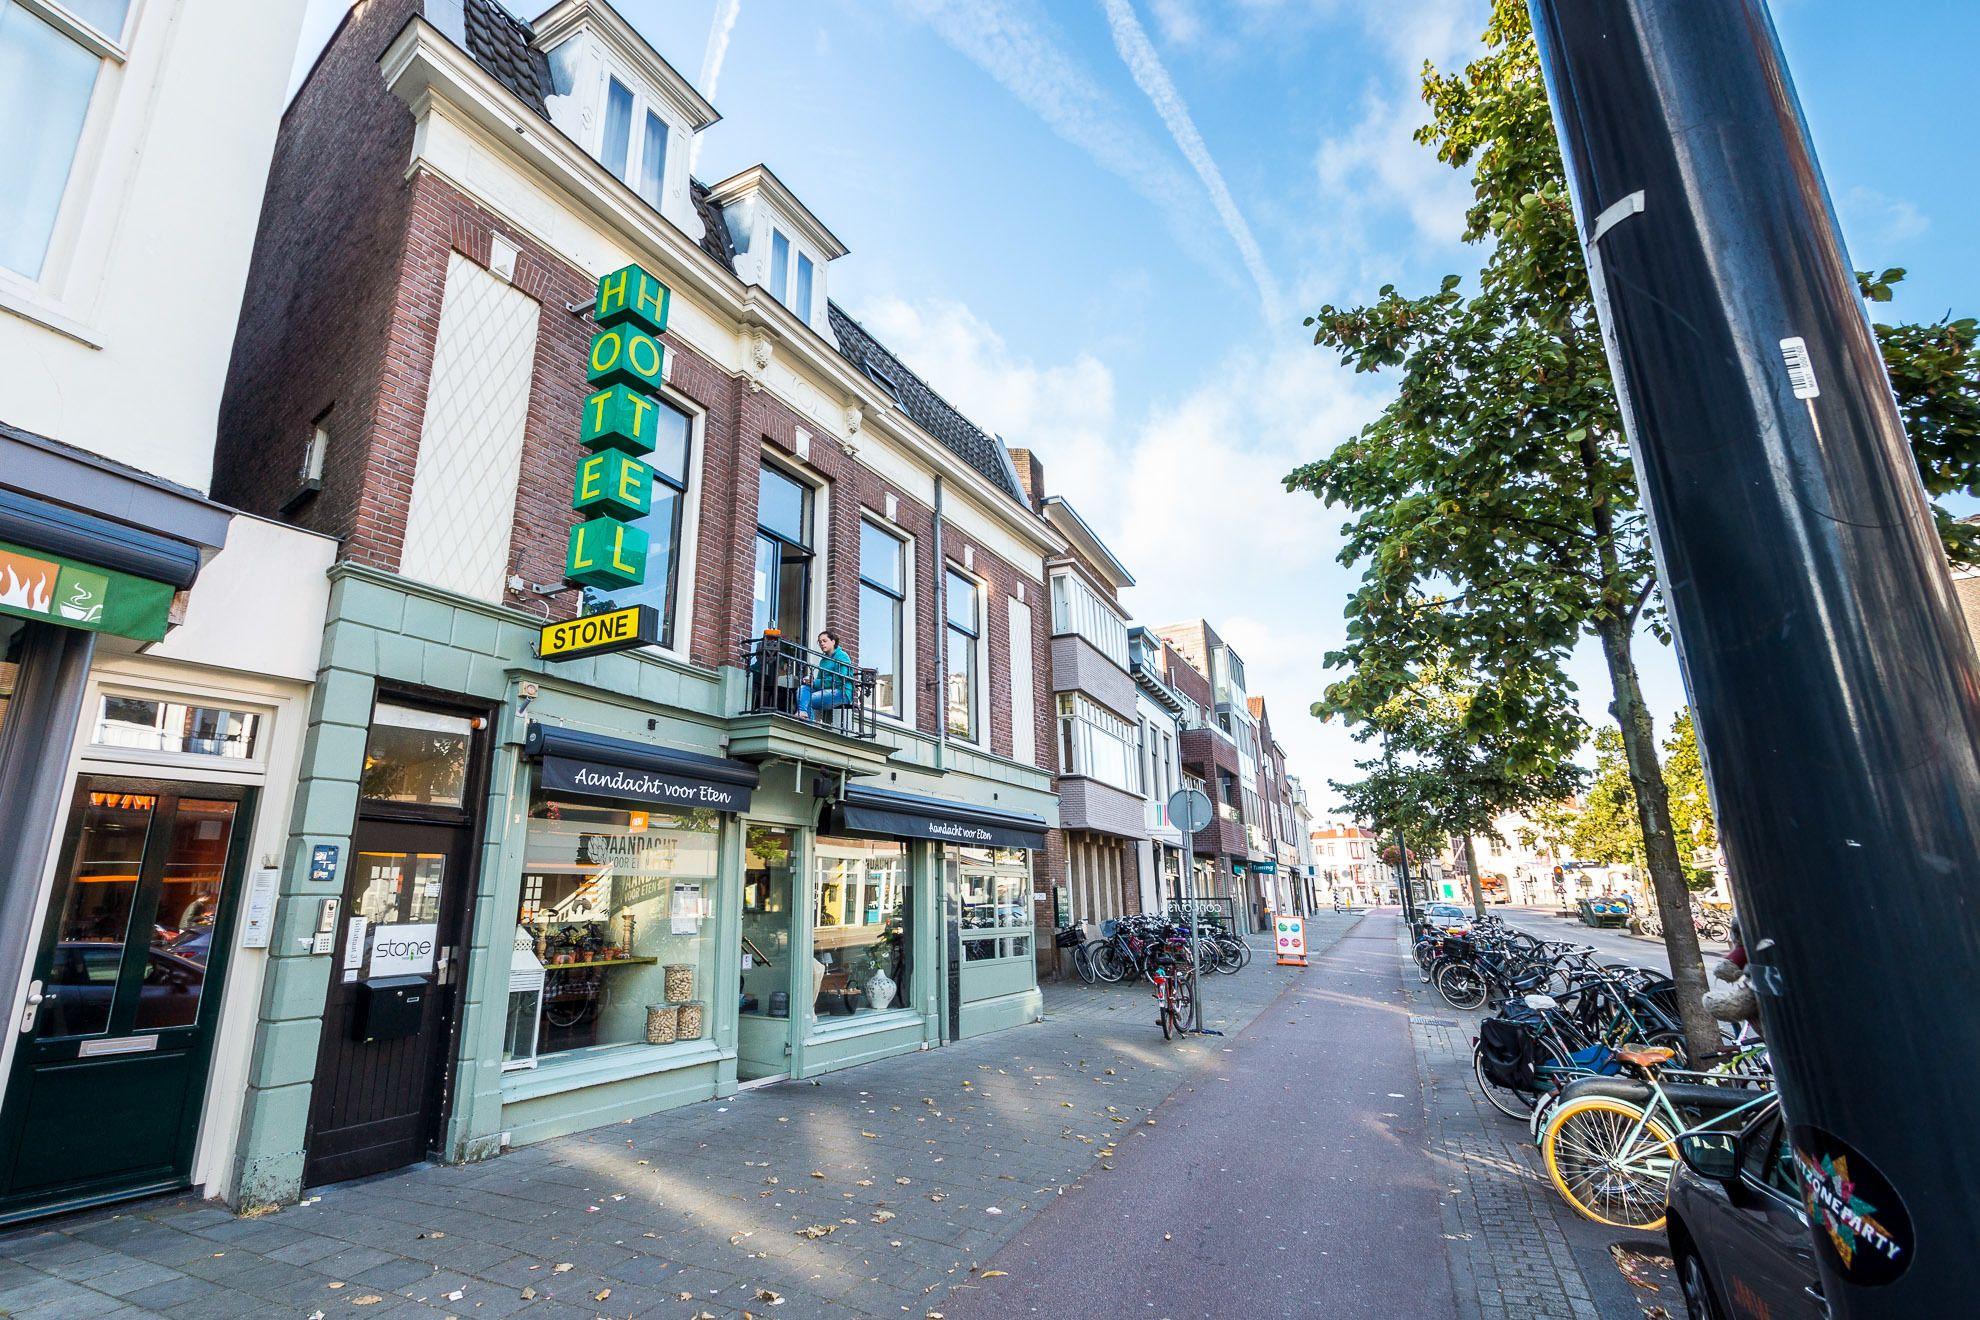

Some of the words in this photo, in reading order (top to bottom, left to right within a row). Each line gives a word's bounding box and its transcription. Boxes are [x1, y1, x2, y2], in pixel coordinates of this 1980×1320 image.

[574, 271, 627, 569] HOTEL
[613, 273, 664, 574] HOTEL
[553, 614, 629, 650] STONE
[574, 768, 663, 795] Aandacht
[664, 783, 697, 799] voor
[699, 786, 732, 804] Eten
[929, 822, 962, 837] Aandacht
[962, 828, 977, 839] voor
[976, 829, 993, 841] Eten
[376, 939, 432, 958] stone
